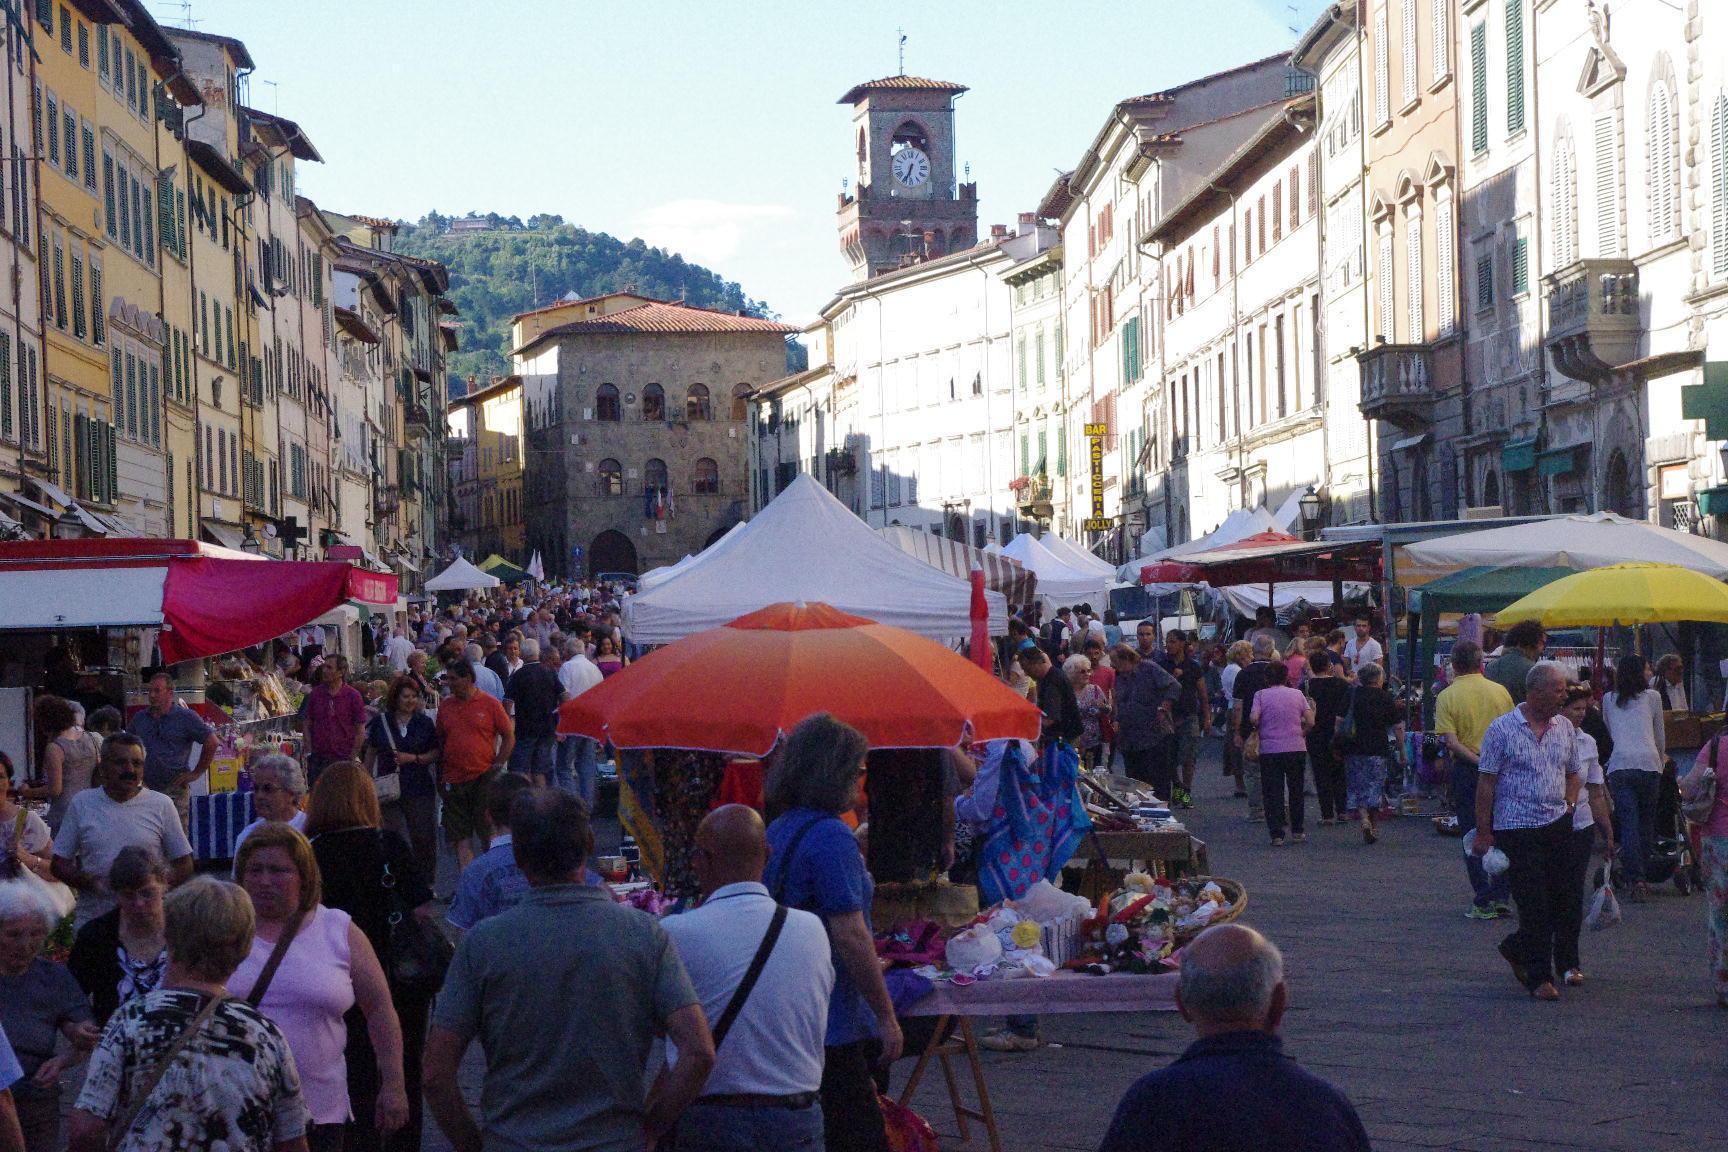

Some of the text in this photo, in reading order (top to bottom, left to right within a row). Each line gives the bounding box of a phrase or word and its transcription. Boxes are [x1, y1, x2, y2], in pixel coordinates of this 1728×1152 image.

[1085, 424, 1107, 434] BAR
[1091, 438, 1102, 517] PASTICCERIA
[1086, 520, 1111, 530] JOLLY
